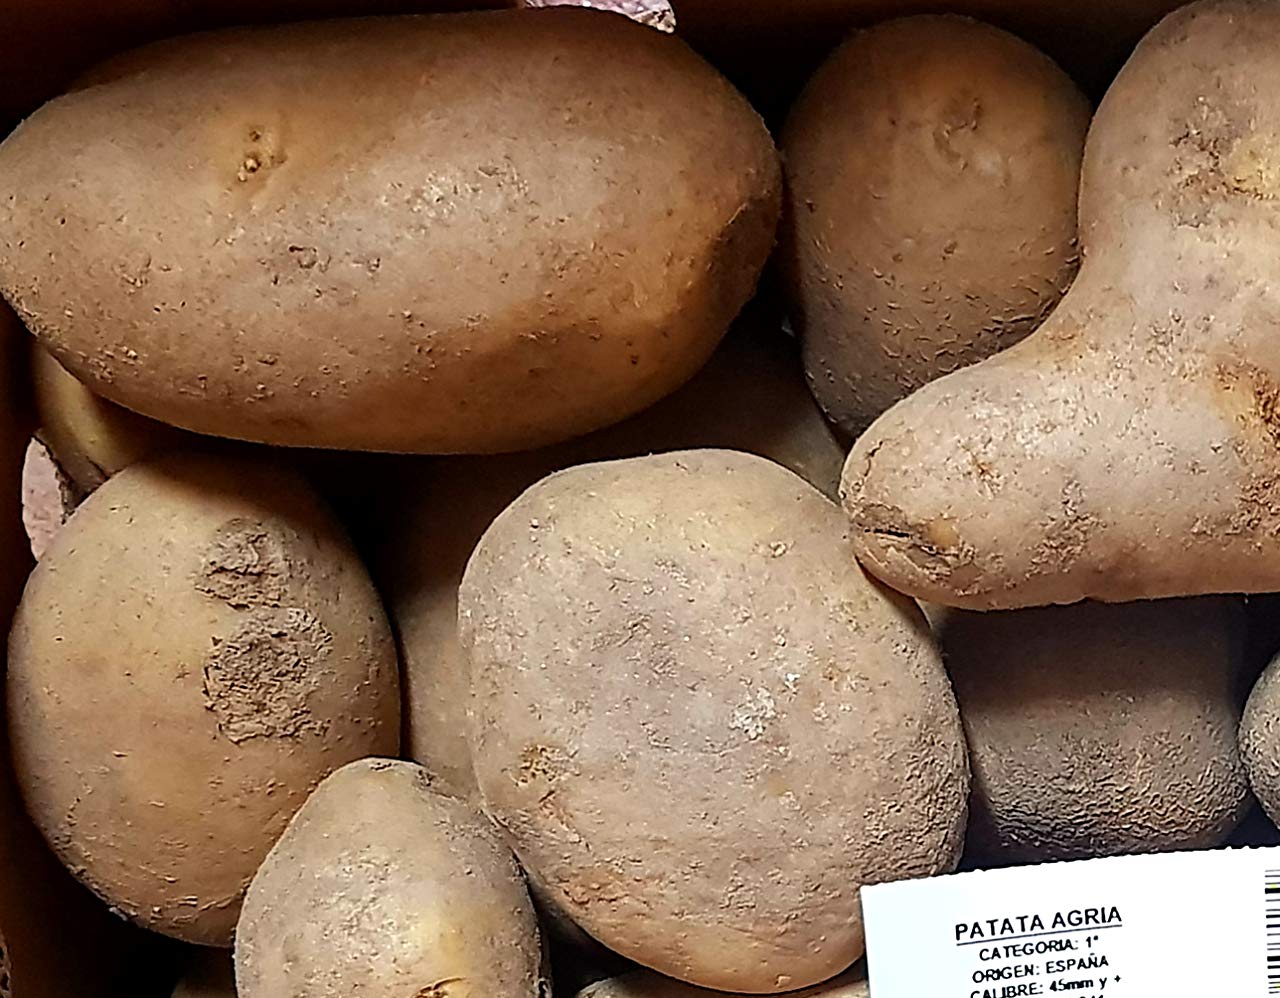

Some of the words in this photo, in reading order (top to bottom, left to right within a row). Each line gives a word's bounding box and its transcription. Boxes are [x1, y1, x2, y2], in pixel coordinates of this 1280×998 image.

[955, 914, 1045, 941] PATATA
[1051, 906, 1122, 929] AGRIA
[979, 938, 1079, 961] CATEGORIA:
[972, 963, 1040, 984] ORIGEN:
[1045, 953, 1109, 974] ESPAÑA
[1049, 978, 1094, 992] 45mm
[1099, 977, 1108, 990] y
